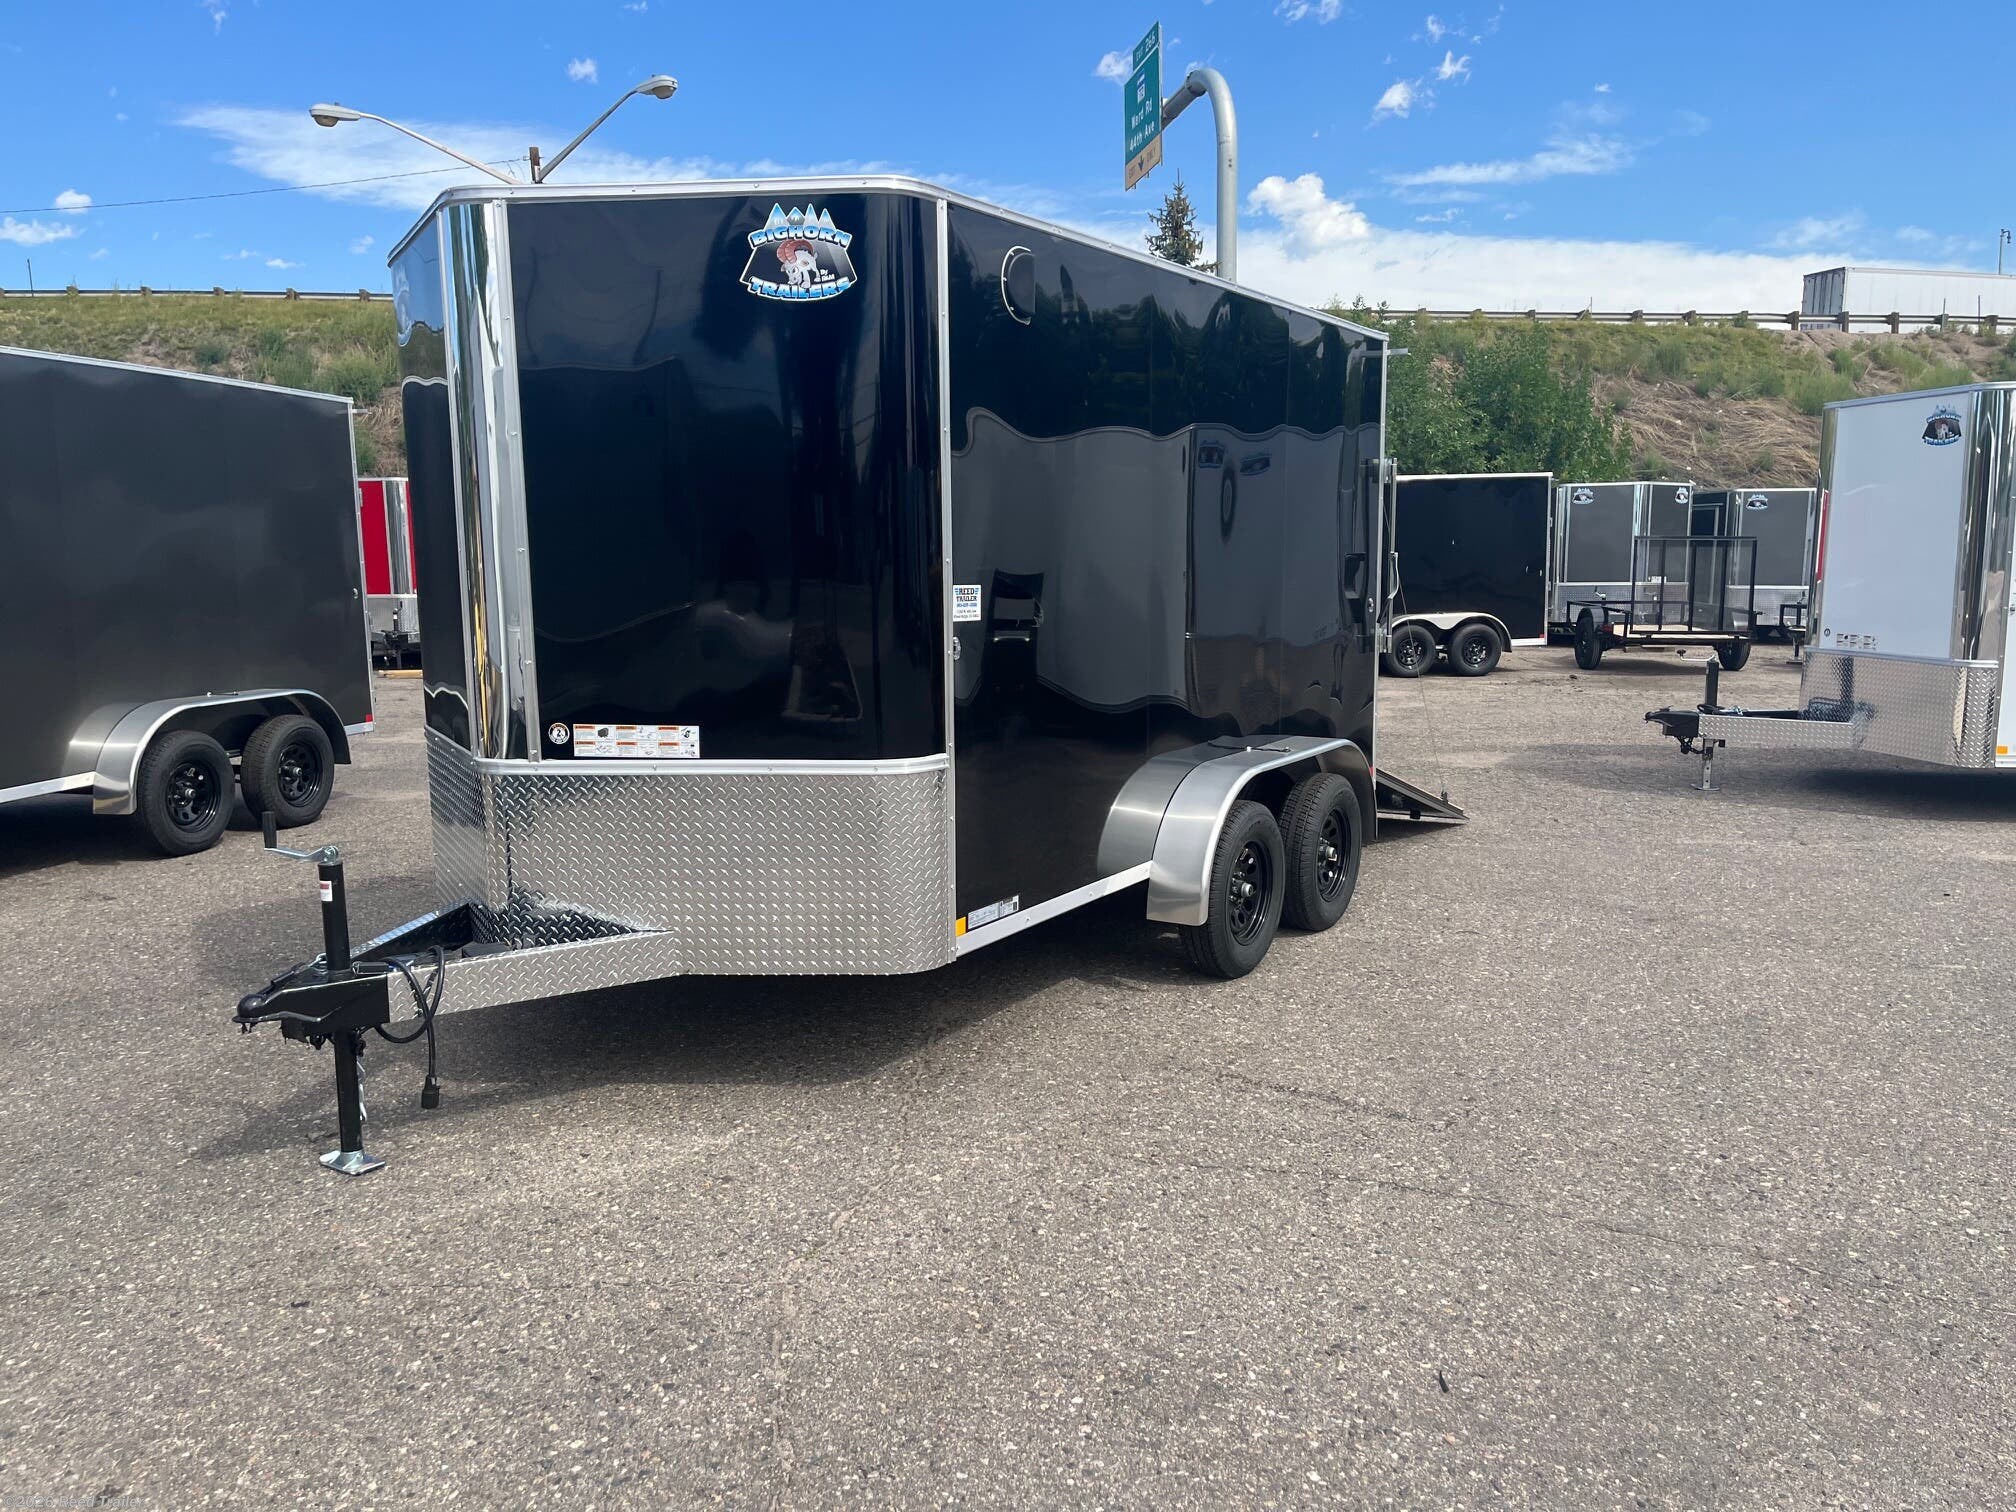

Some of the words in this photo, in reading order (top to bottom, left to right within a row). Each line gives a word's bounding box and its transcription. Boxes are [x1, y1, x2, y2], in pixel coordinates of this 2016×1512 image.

[1131, 106, 1144, 130] Ward
[1145, 97, 1153, 116] Rd
[1129, 131, 1143, 152] 44th
[1144, 121, 1155, 139] Ave
[749, 225, 852, 248] BIGHORN
[750, 276, 850, 299] TRAILERS
[958, 587, 975, 595] REED
